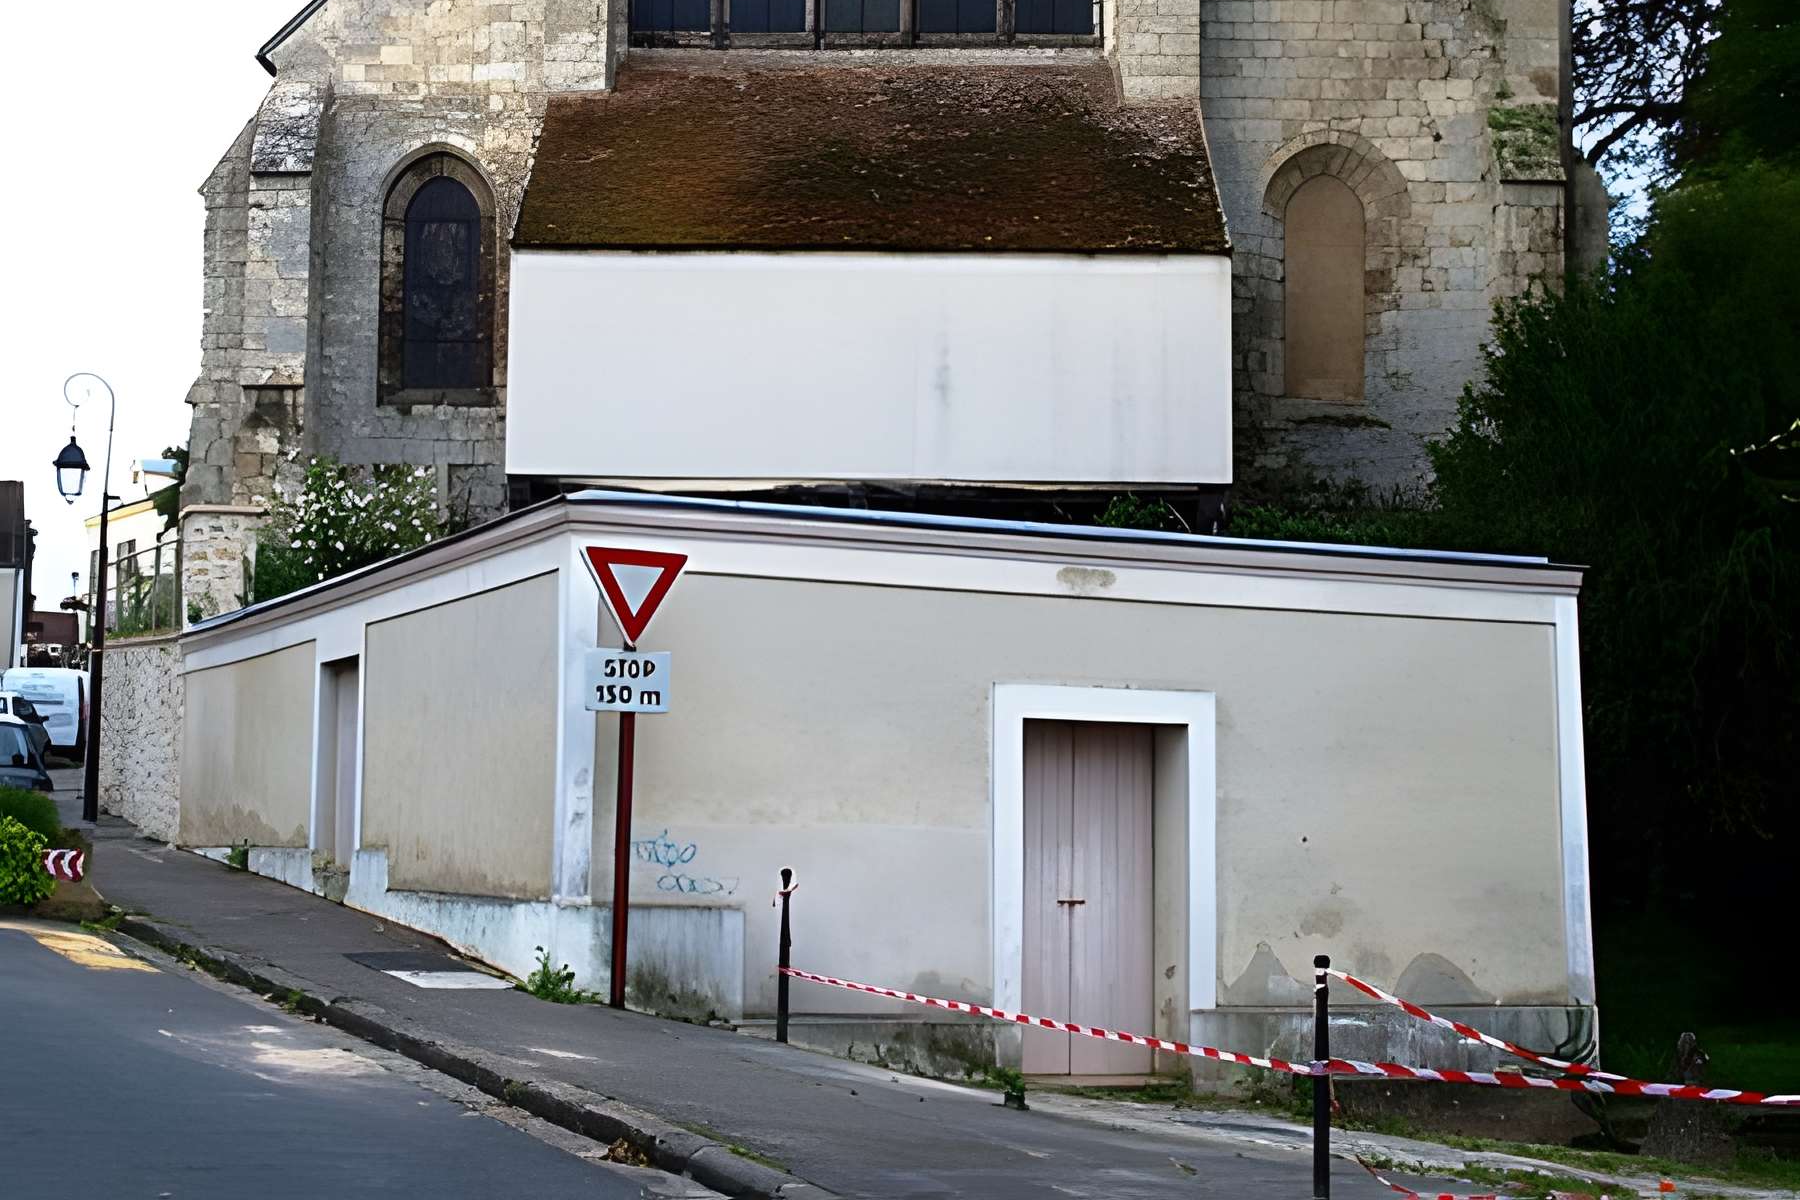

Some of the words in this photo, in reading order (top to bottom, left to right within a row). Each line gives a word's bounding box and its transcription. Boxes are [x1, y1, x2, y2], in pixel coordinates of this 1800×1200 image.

[604, 658, 656, 679] STOP
[596, 685, 633, 704] 150
[639, 690, 661, 706] m
